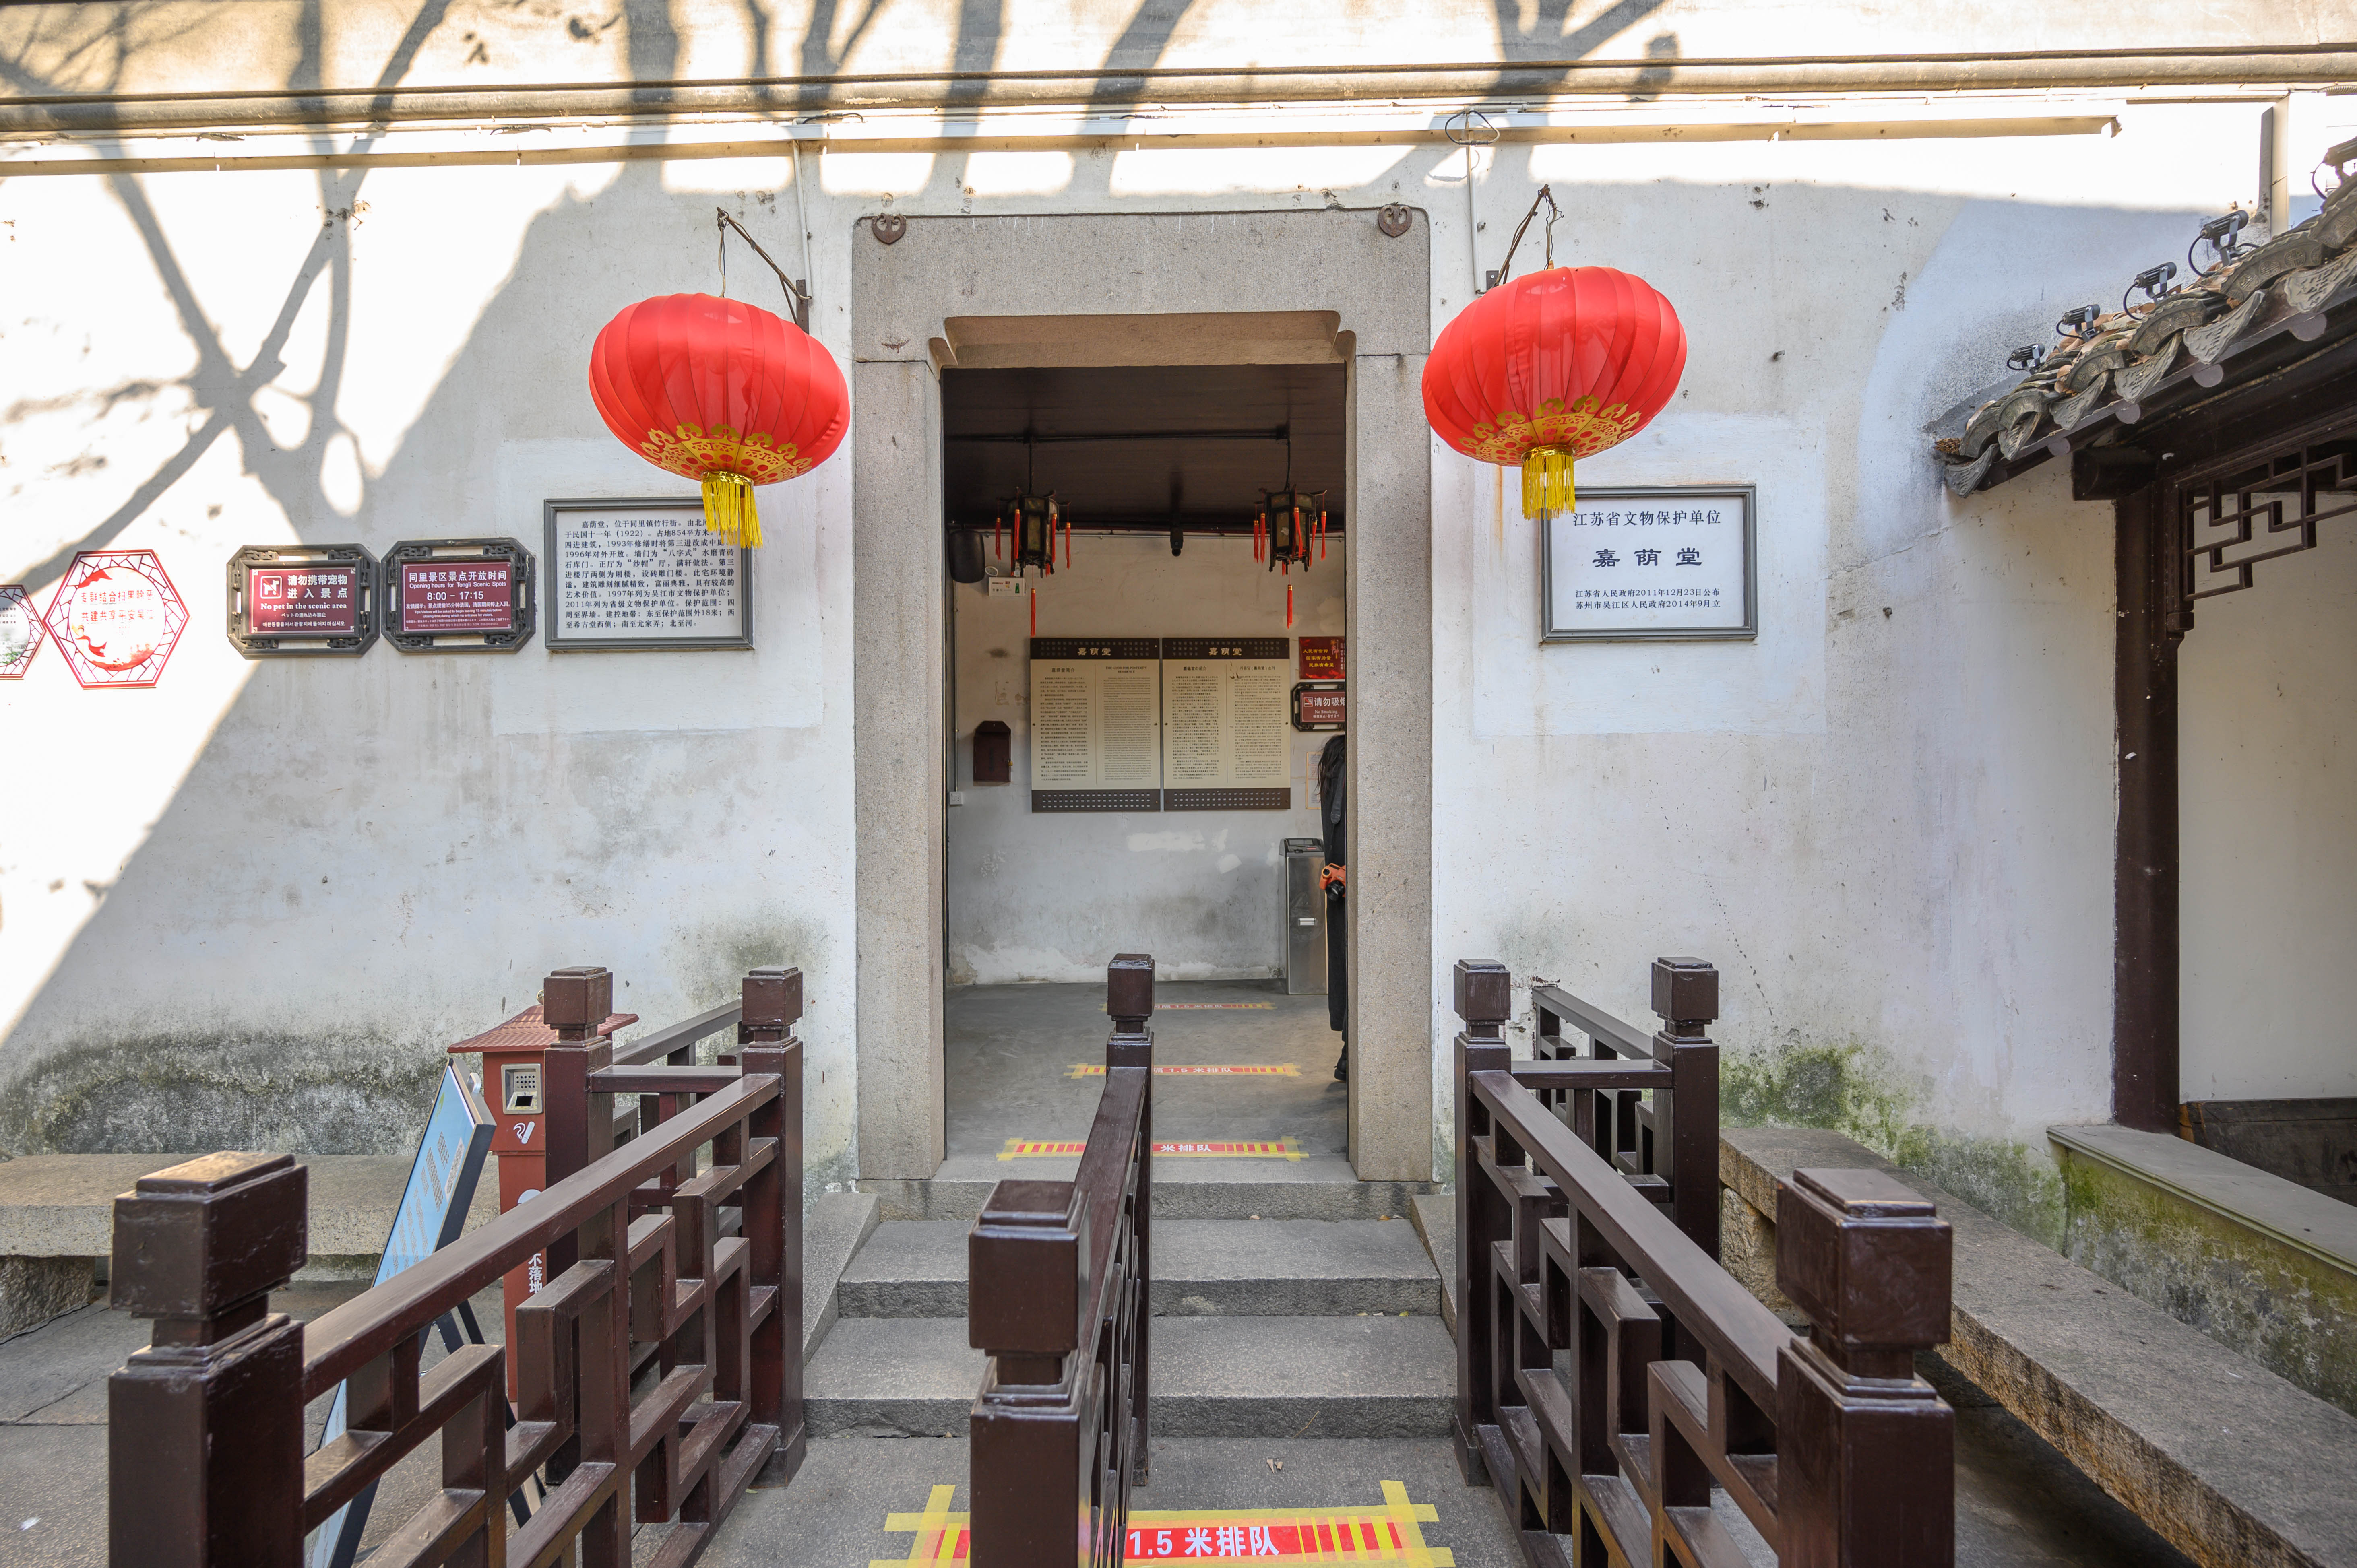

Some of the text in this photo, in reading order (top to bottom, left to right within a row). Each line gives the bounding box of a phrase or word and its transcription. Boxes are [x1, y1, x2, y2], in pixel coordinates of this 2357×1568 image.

[1573, 510, 1721, 527] 江苏省文物保护单位
[1592, 547, 1702, 568] 嘉荫堂
[409, 571, 506, 582] 同里景区景点开放时间
[565, 569, 734, 579] 进楼厅两侧为厢楼，设砖雕门楼。此宅环境静
[287, 574, 348, 586] 请勿携带宠物
[287, 588, 348, 599] 进入景点
[427, 592, 447, 600] 8:00
[459, 591, 484, 600] 17:15
[1575, 588, 1720, 598] 江苏省人民政府2011年12月23日公布
[1575, 599, 1721, 610] 苏州市吴江区人民政府2014年9月立
[1077, 647, 1111, 656] 嘉荫堂
[1208, 647, 1242, 656] 嘉荫堂
[1314, 697, 1345, 707] 请勿吸烟
[1160, 1144, 1213, 1152] 米排队
[1129, 1526, 1279, 1557] 1.5 米排队
